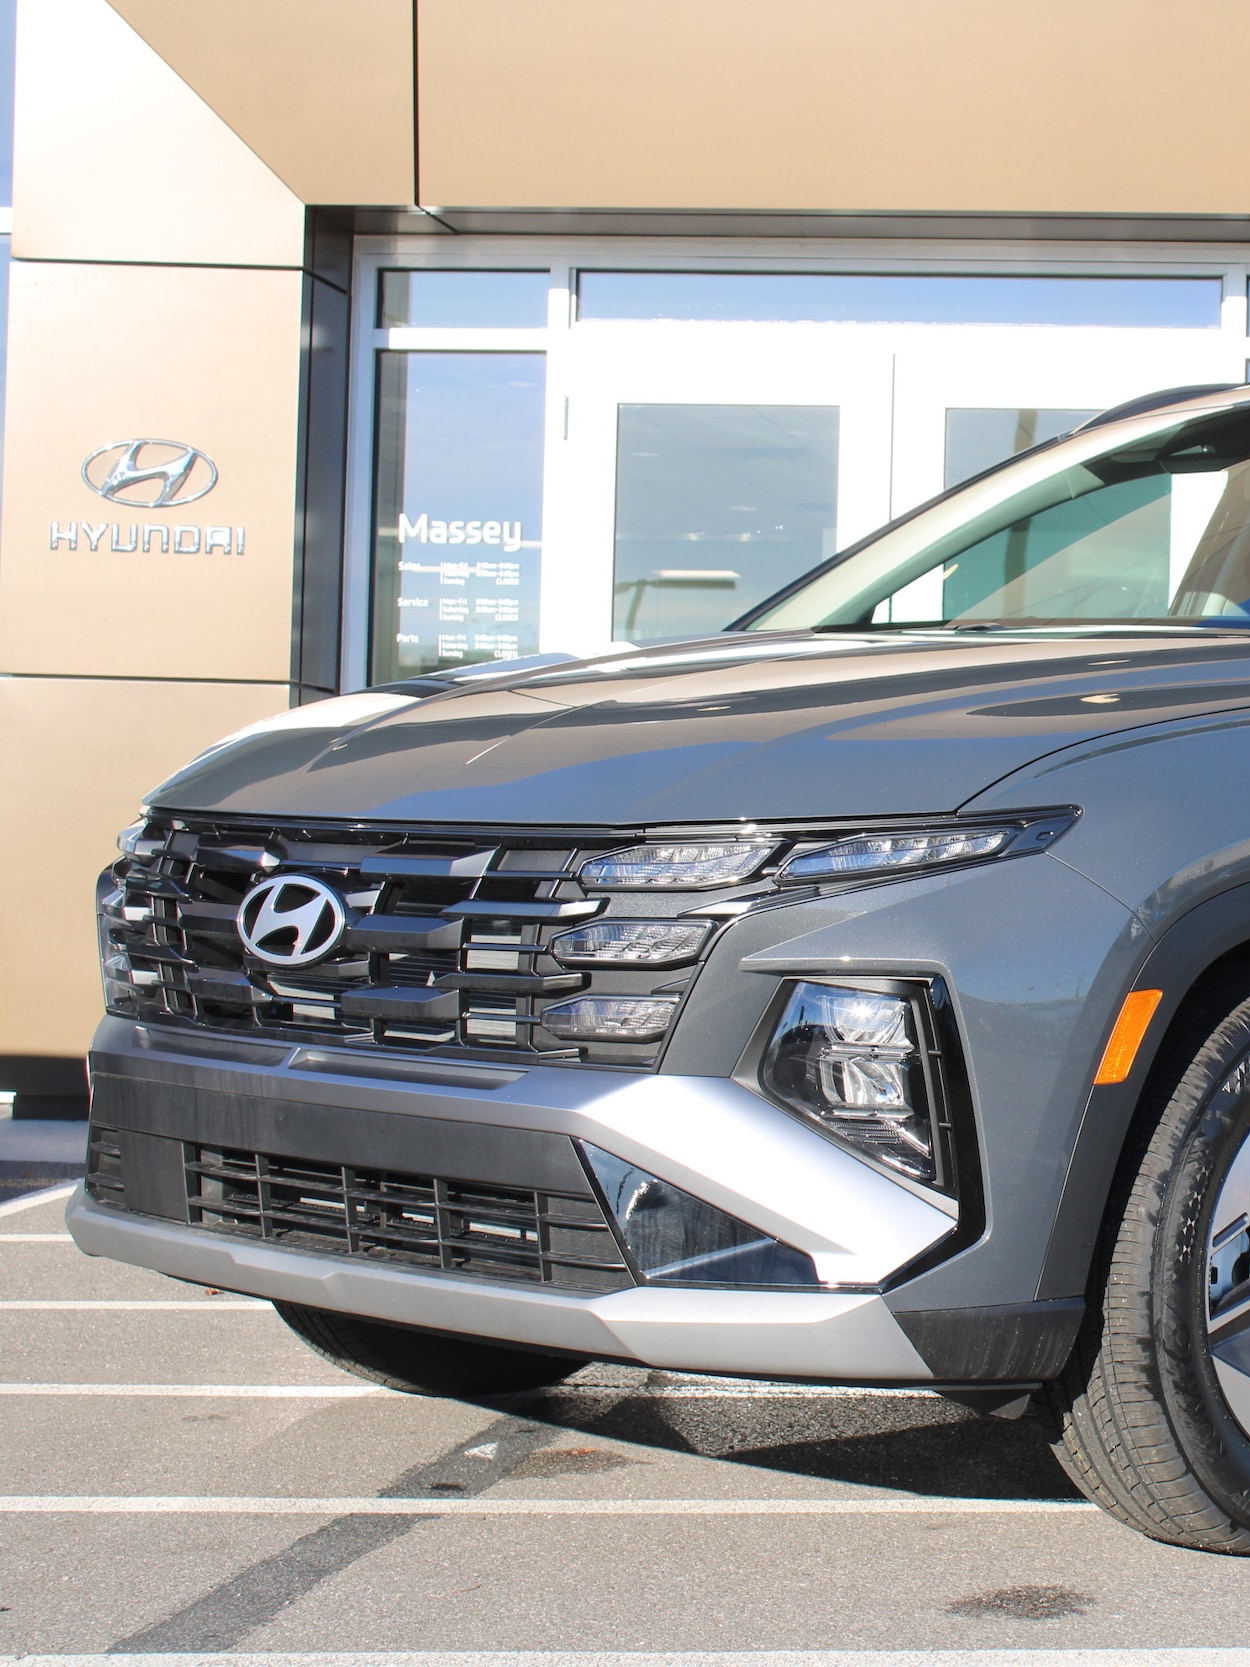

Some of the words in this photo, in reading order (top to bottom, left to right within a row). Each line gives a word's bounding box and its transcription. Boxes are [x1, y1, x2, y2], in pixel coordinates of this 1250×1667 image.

[398, 513, 522, 552] Massey
[50, 520, 246, 556] HYUNDAI
[496, 578, 520, 586] CLOSED
[397, 597, 429, 607] Service
[495, 614, 519, 622] CLOSED
[396, 633, 419, 643] Parts
